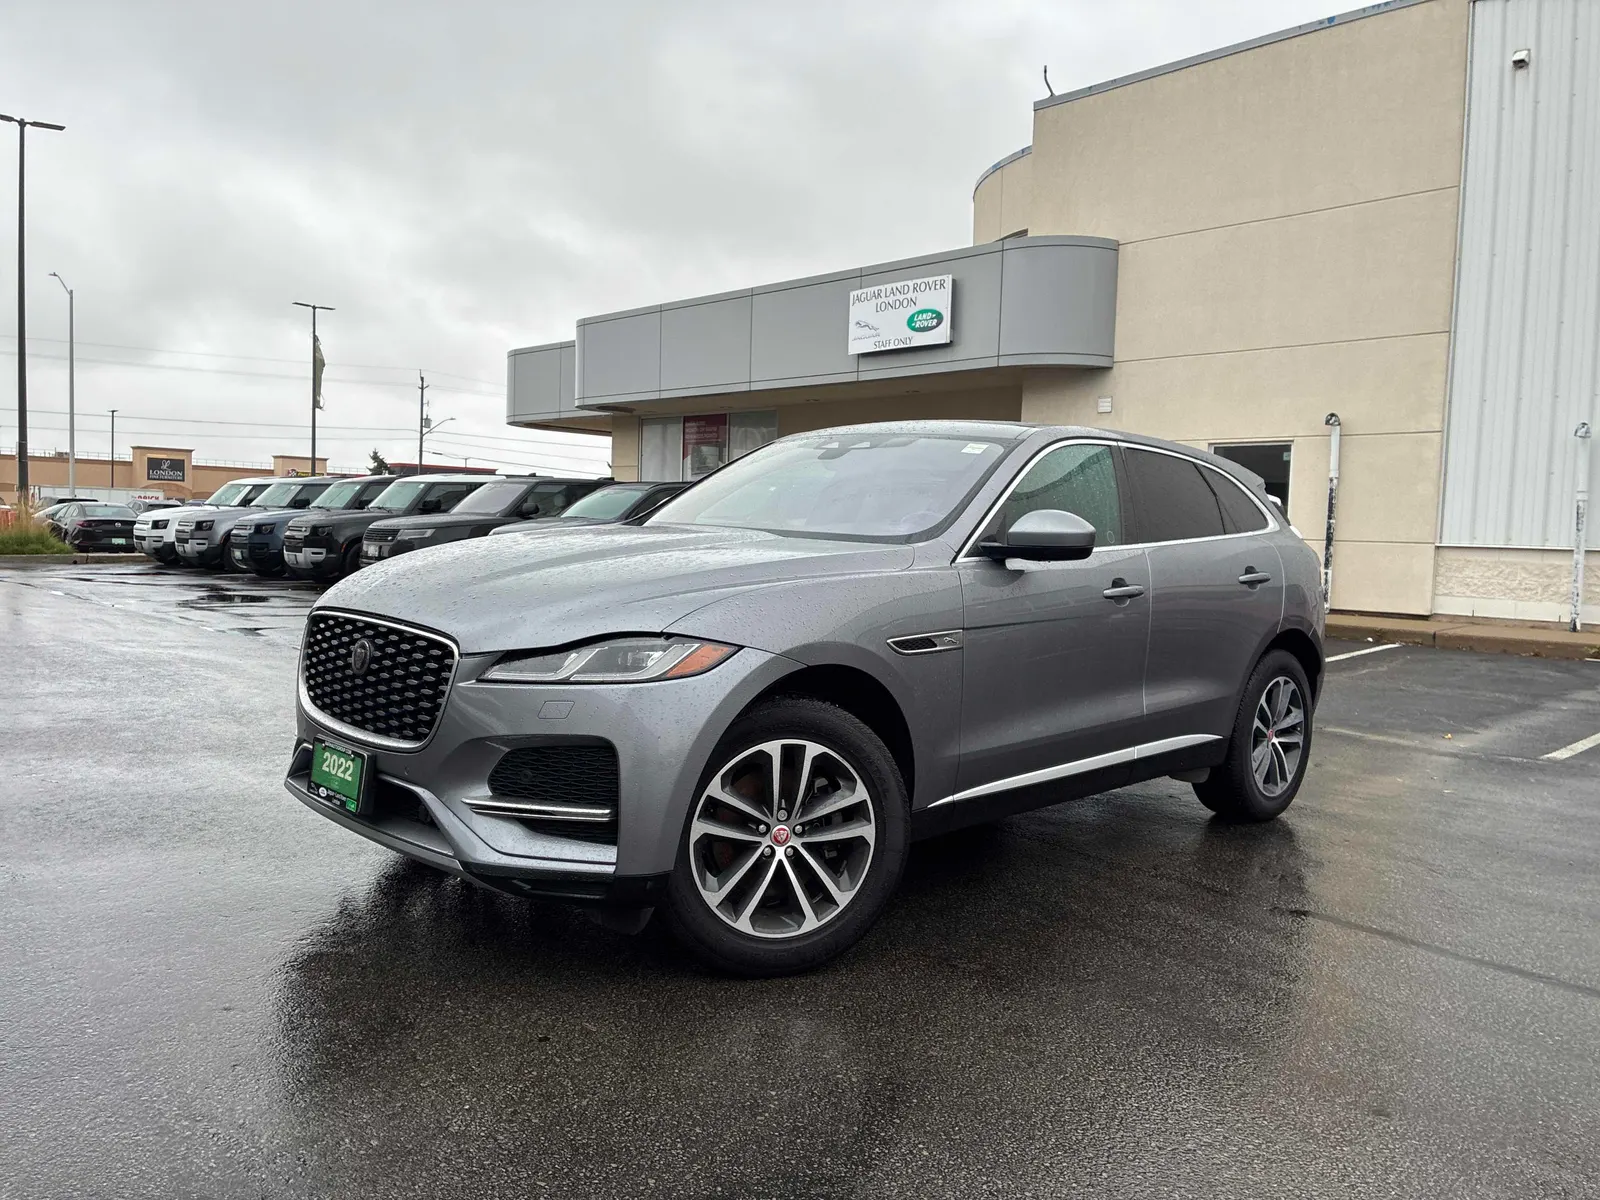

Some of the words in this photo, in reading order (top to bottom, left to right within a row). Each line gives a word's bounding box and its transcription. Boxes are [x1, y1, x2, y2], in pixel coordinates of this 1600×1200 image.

[852, 289, 882, 306] JAGUAR
[884, 284, 910, 298] LAND
[912, 279, 946, 293] ROVER
[875, 297, 917, 312] LONDON
[873, 339, 892, 349] STAFF
[893, 336, 914, 347] ONLY
[322, 751, 354, 781] 2022
